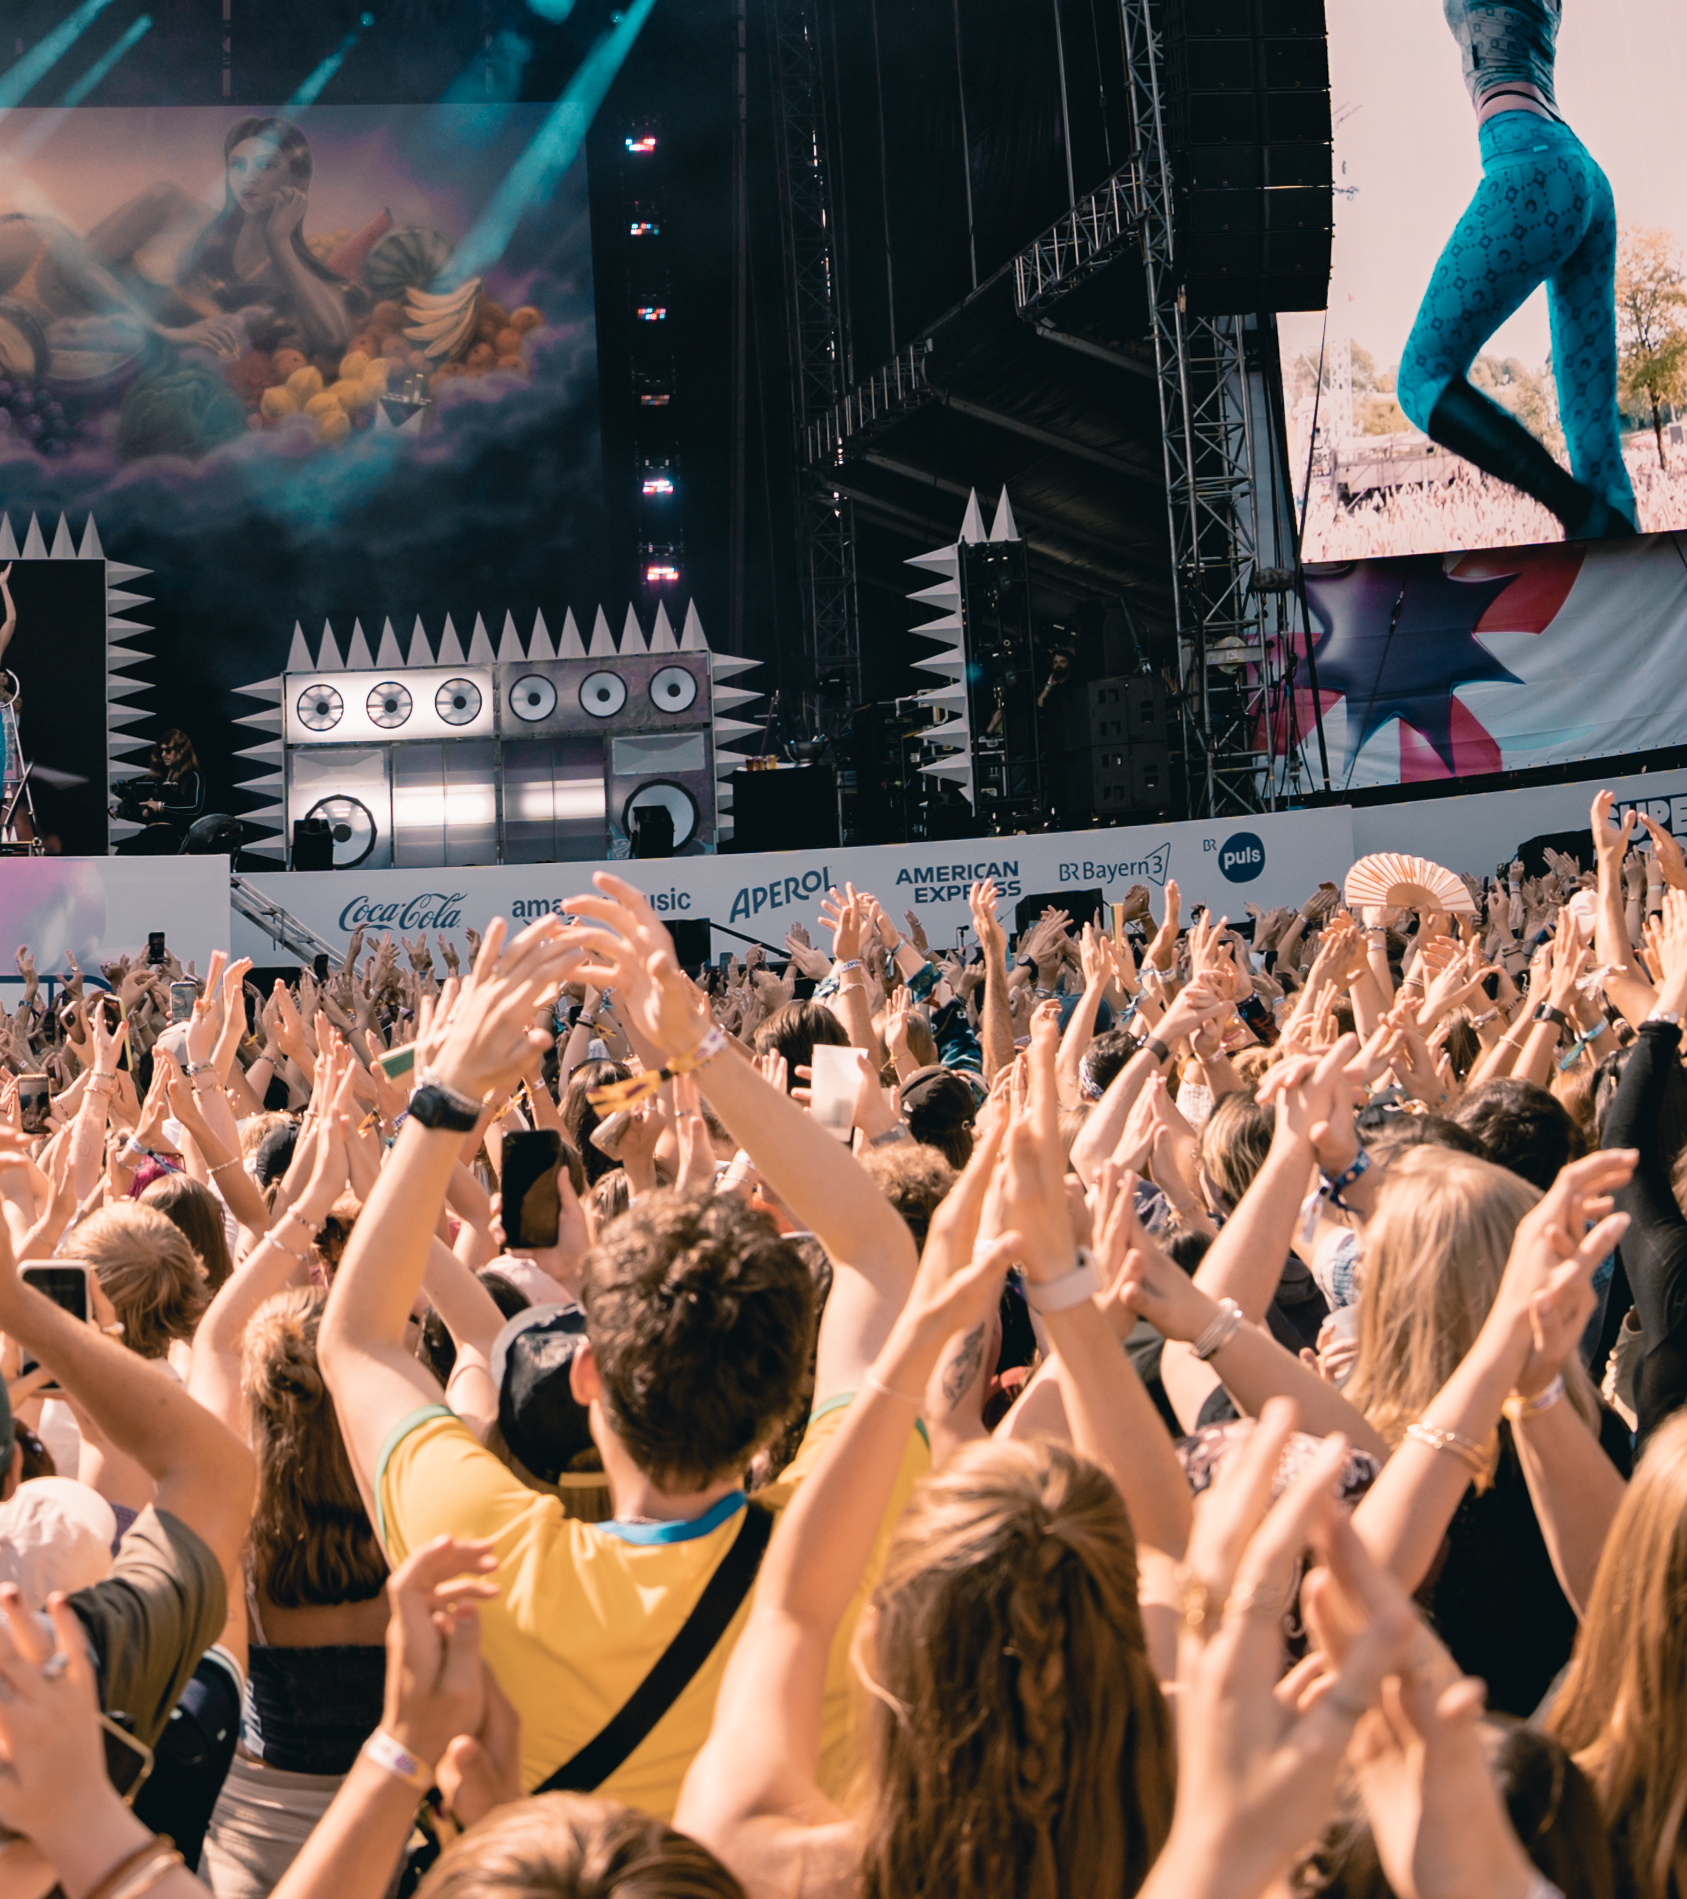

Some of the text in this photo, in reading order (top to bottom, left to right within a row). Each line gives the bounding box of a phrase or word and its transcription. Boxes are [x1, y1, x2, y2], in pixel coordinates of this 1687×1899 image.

[1203, 839, 1217, 852] BR
[1224, 848, 1261, 869] puls
[895, 860, 1019, 885] AMERICAN
[1082, 858, 1148, 886] Bayern
[1148, 856, 1164, 876] 3
[512, 886, 692, 919] ama sic
[729, 867, 832, 923] APEROL
[914, 880, 1022, 904] EXPSS
[338, 892, 469, 931] Coca-Cola
